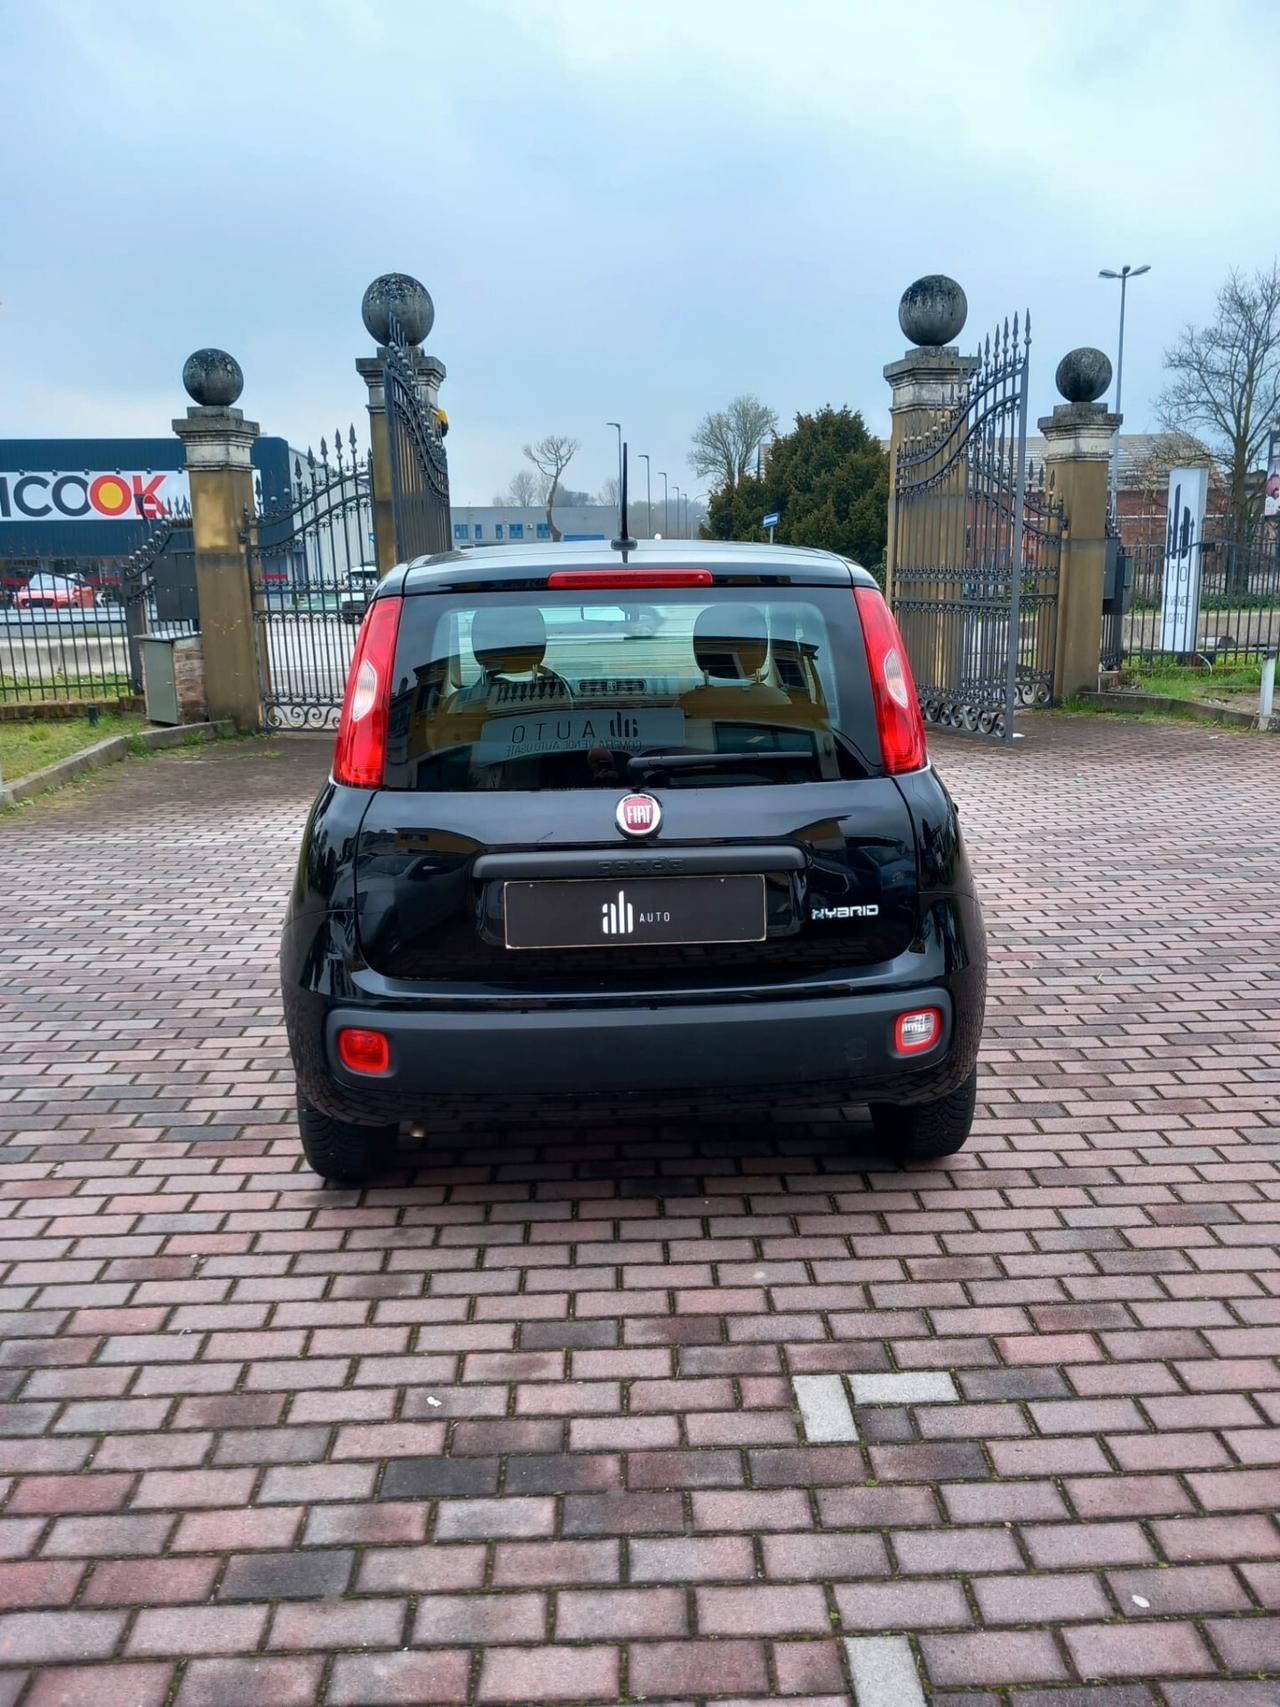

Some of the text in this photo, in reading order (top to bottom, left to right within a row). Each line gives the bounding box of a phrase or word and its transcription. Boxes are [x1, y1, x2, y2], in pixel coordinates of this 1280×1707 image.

[626, 804, 652, 824] FIAT
[639, 911, 671, 923] AUTO
[811, 903, 879, 921] HYBRID
